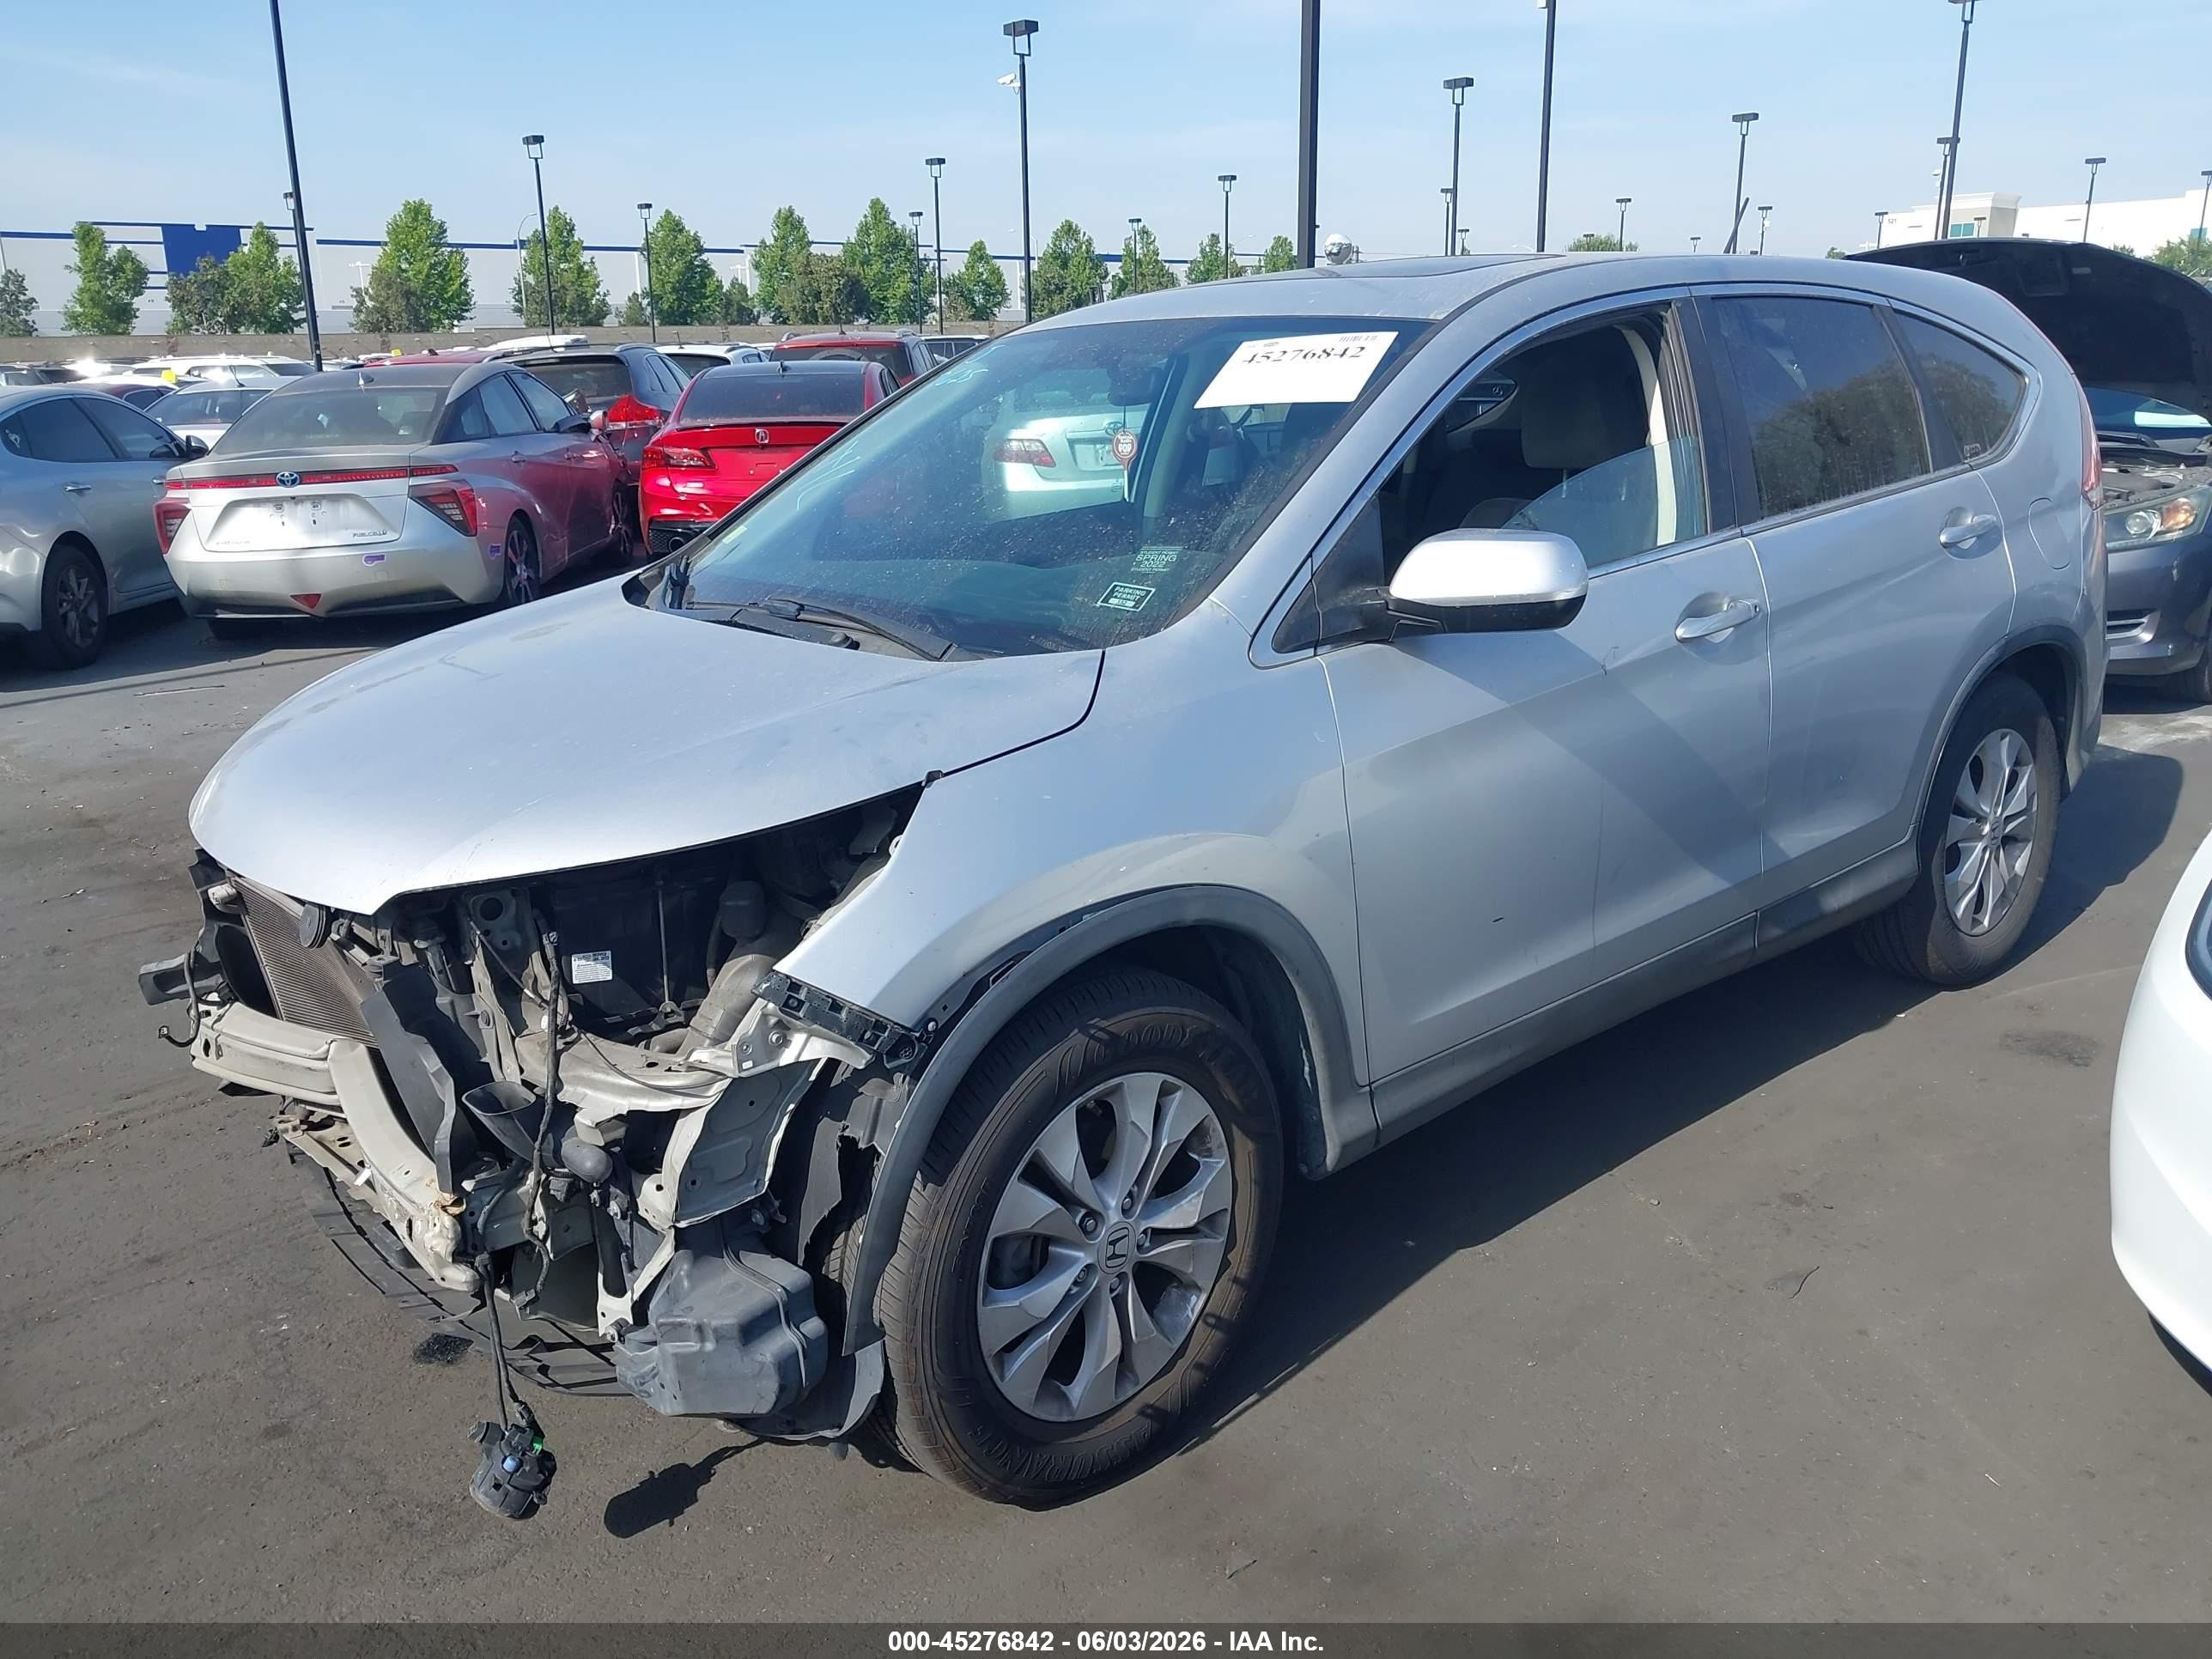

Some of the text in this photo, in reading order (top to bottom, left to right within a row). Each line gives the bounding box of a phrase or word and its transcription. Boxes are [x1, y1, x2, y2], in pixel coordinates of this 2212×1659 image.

[1243, 346, 1365, 364] 45276842
[1135, 554, 1177, 562] SPRING
[1112, 592, 1141, 601] PERMIT
[1114, 586, 1147, 597] PARKING
